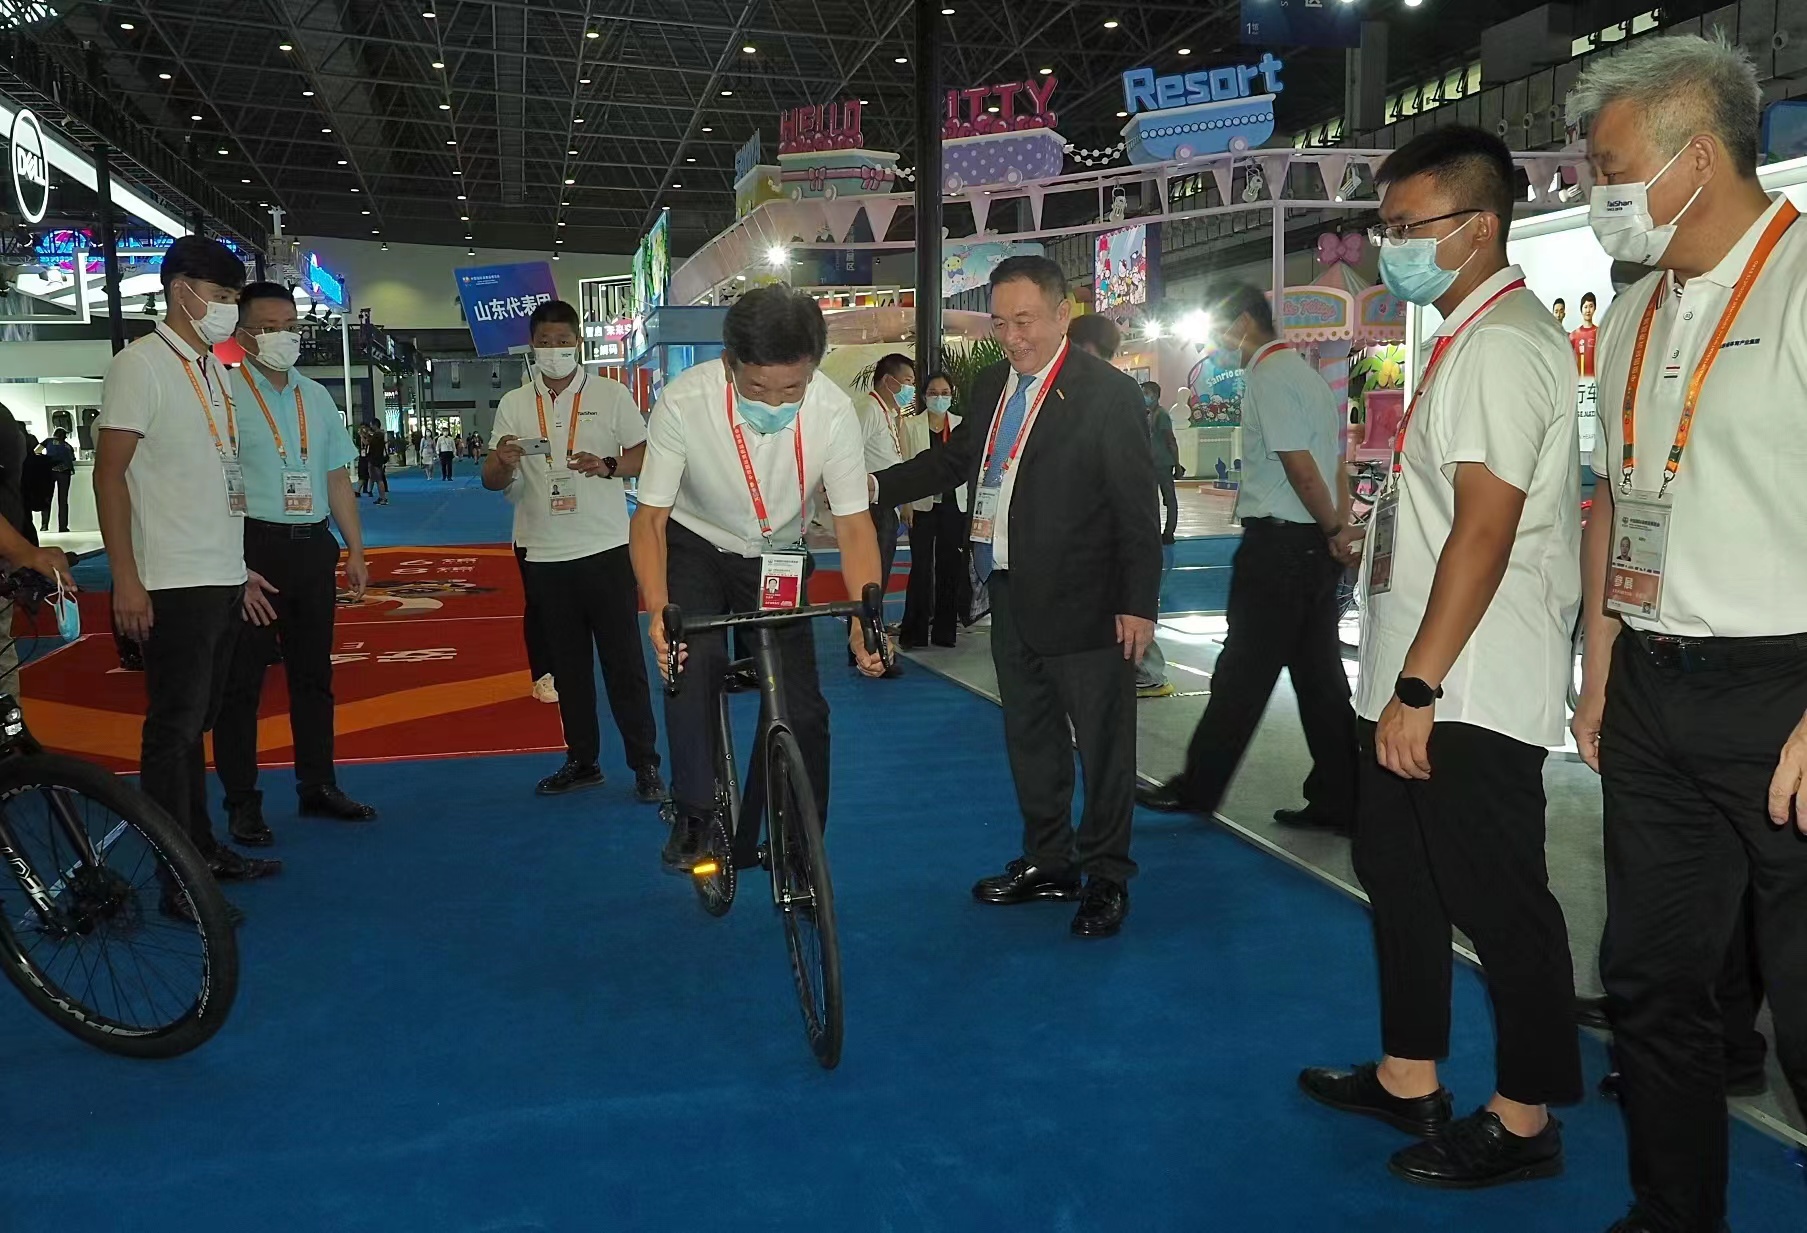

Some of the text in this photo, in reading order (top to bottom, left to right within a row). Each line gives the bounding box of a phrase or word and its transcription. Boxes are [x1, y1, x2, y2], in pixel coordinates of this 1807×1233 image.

[780, 53, 1284, 141] HELLO ITTY Resort
[17, 146, 46, 187] DELL
[1206, 370, 1234, 388] Sanrio
